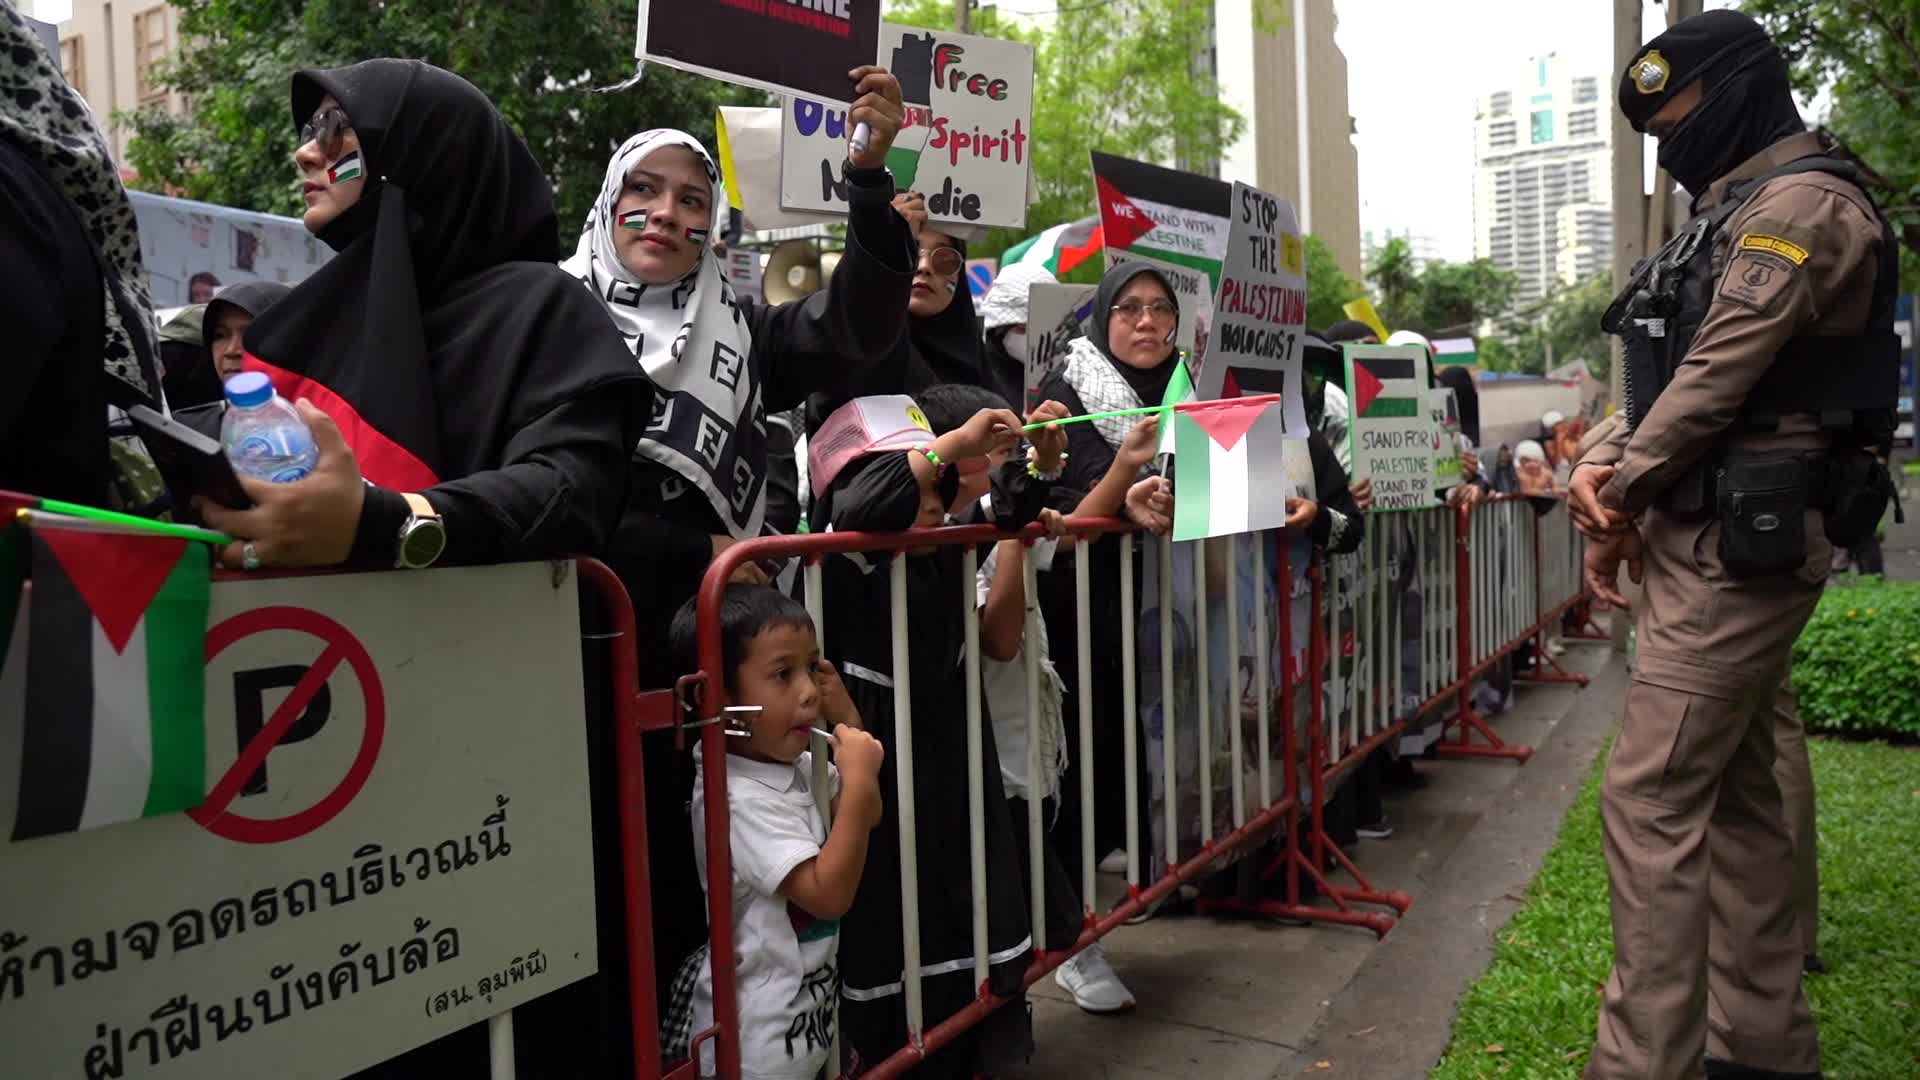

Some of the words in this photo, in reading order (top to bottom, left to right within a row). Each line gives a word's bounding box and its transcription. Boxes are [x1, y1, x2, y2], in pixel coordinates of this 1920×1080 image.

[794, 99, 848, 138] Ou
[933, 44, 1009, 100] Free
[929, 118, 1027, 167] Spirit
[930, 177, 981, 221] die
[1111, 202, 1136, 220] WE
[1183, 217, 1217, 235] WITH
[1242, 188, 1278, 235] STOP
[1249, 235, 1277, 275] THE
[1220, 322, 1296, 361] HOLOCAUST
[1362, 430, 1402, 450] STAND
[1404, 430, 1429, 449] FOR
[1370, 457, 1429, 475] PALESTINE
[1374, 480, 1408, 494] STAND
[1411, 478, 1428, 490] FOR
[233, 664, 332, 798] P
[0, 794, 512, 999] ห้ามจอดรถบริเวณนี้
[83, 917, 460, 1080] ฝ่าฝืนบังคับล้อ
